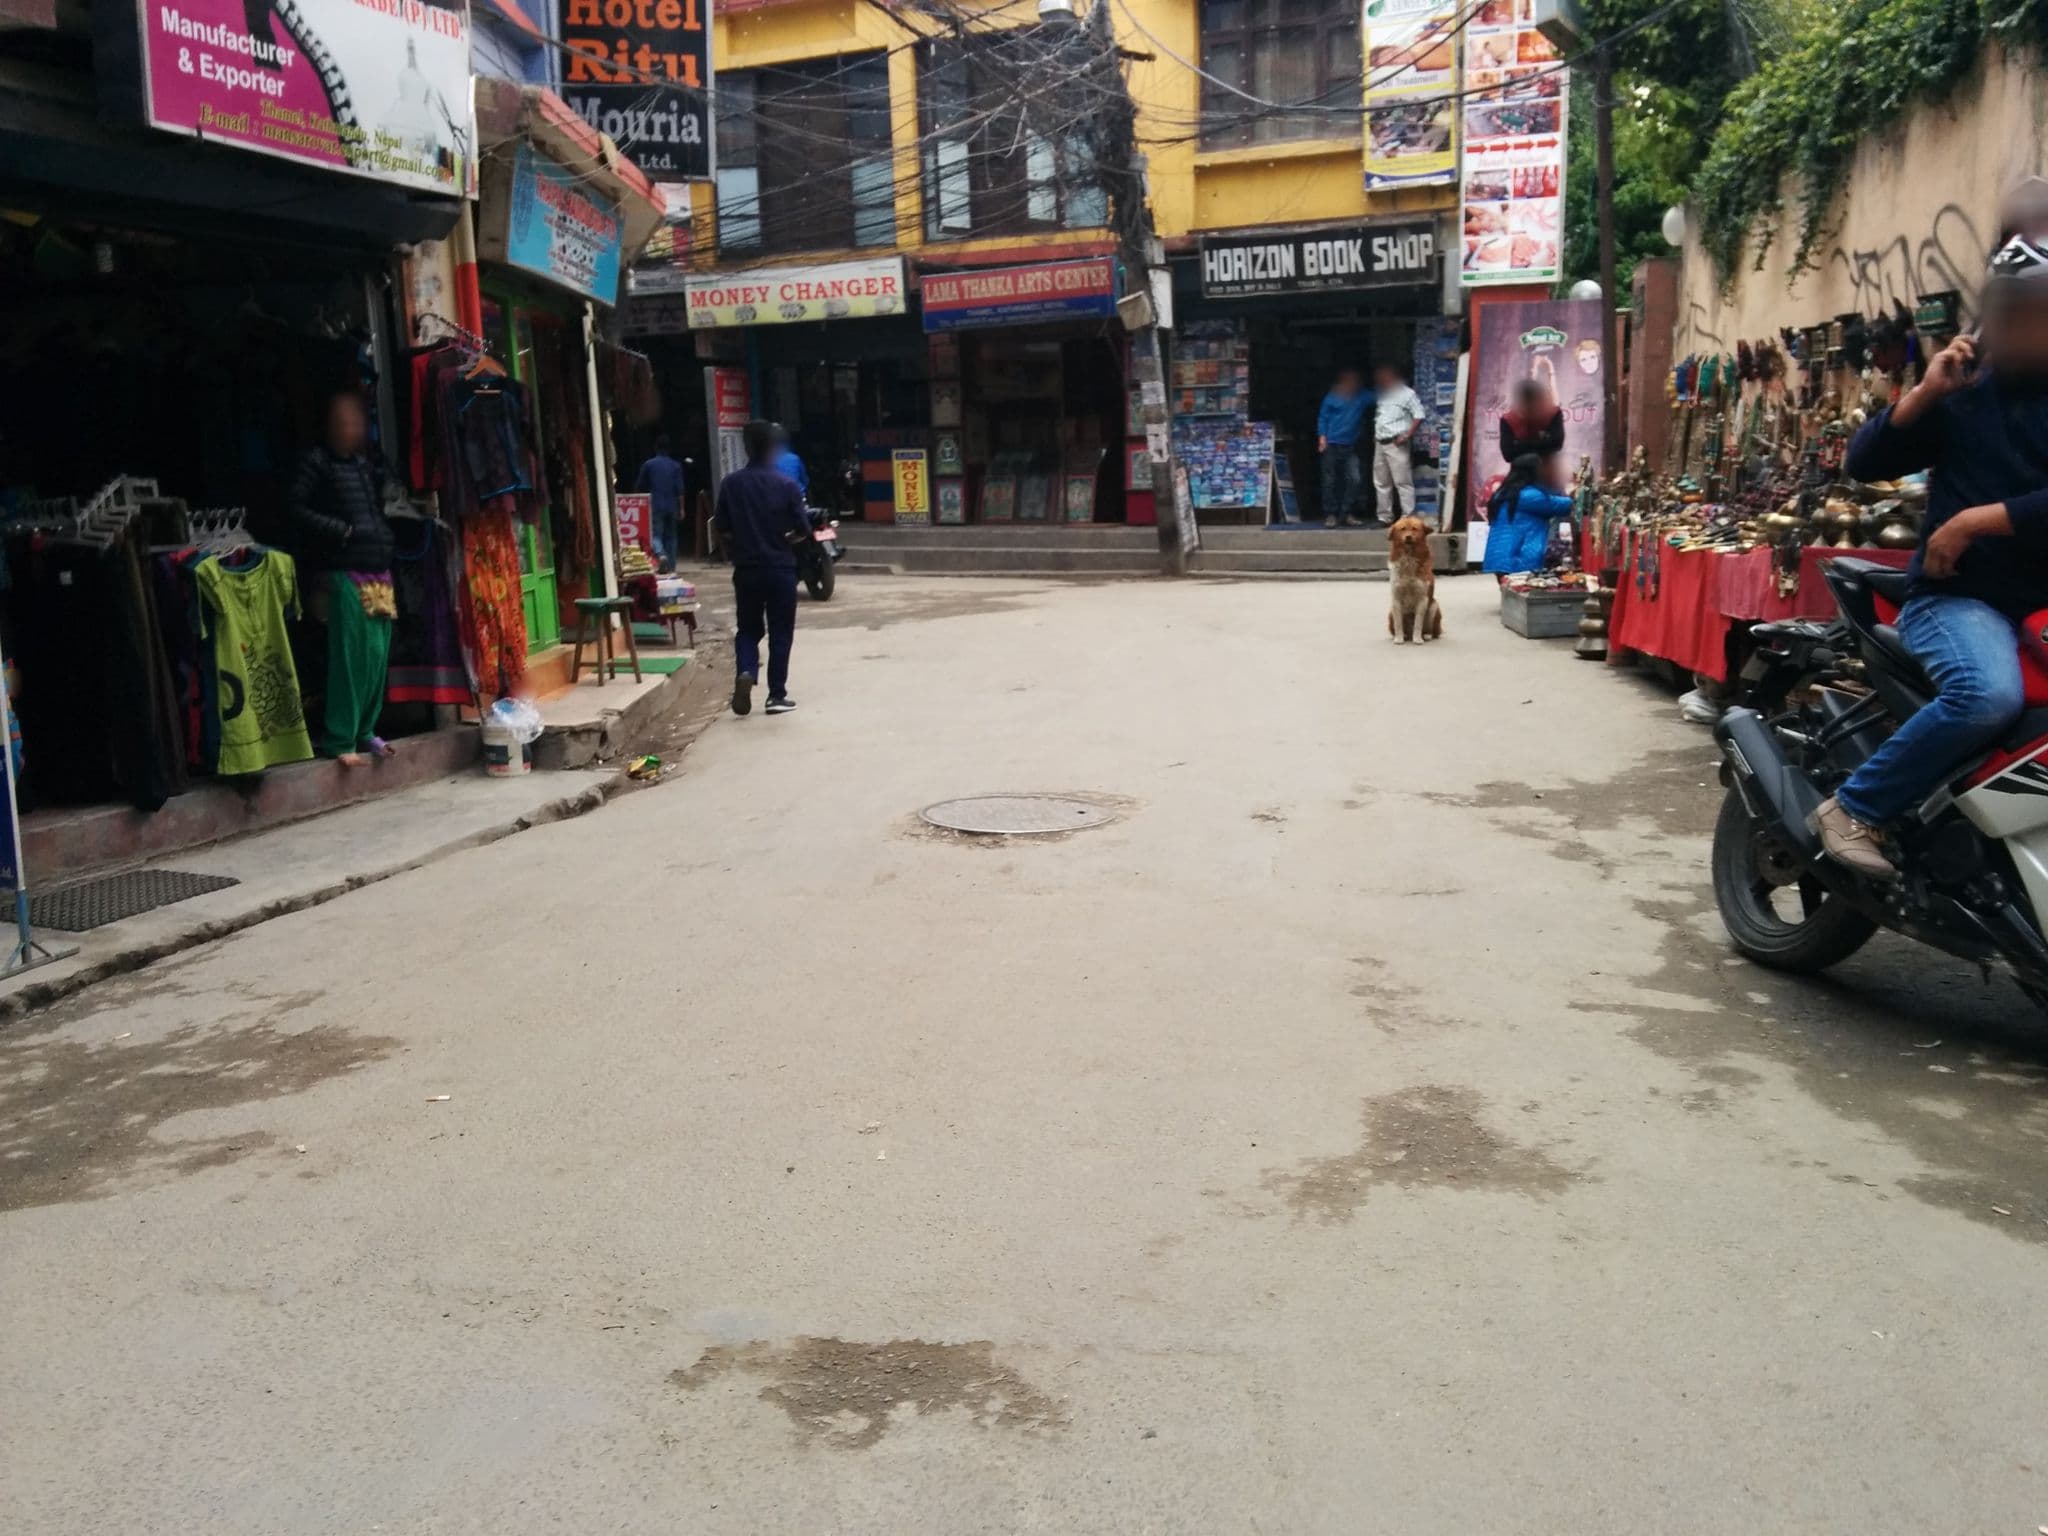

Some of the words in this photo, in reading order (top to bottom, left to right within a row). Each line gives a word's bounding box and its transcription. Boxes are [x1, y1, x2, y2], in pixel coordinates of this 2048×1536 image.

[161, 6, 295, 67] Manufacturer
[565, 0, 702, 31] Hotel
[178, 47, 194, 74] &
[200, 53, 285, 97] Exporter
[567, 38, 702, 88] Ritu
[568, 97, 702, 144] Mouria
[639, 153, 678, 169] Ltd.
[1205, 243, 1297, 283] HORIZON
[1302, 239, 1366, 277] BOOK
[1372, 233, 1433, 273] SHOP
[690, 286, 770, 309] MONEY
[780, 276, 898, 302] CHANGER
[924, 281, 959, 304] LAMA
[962, 276, 1015, 300] THANKA
[1017, 270, 1053, 294] ARTS
[1055, 265, 1111, 291] CENTER
